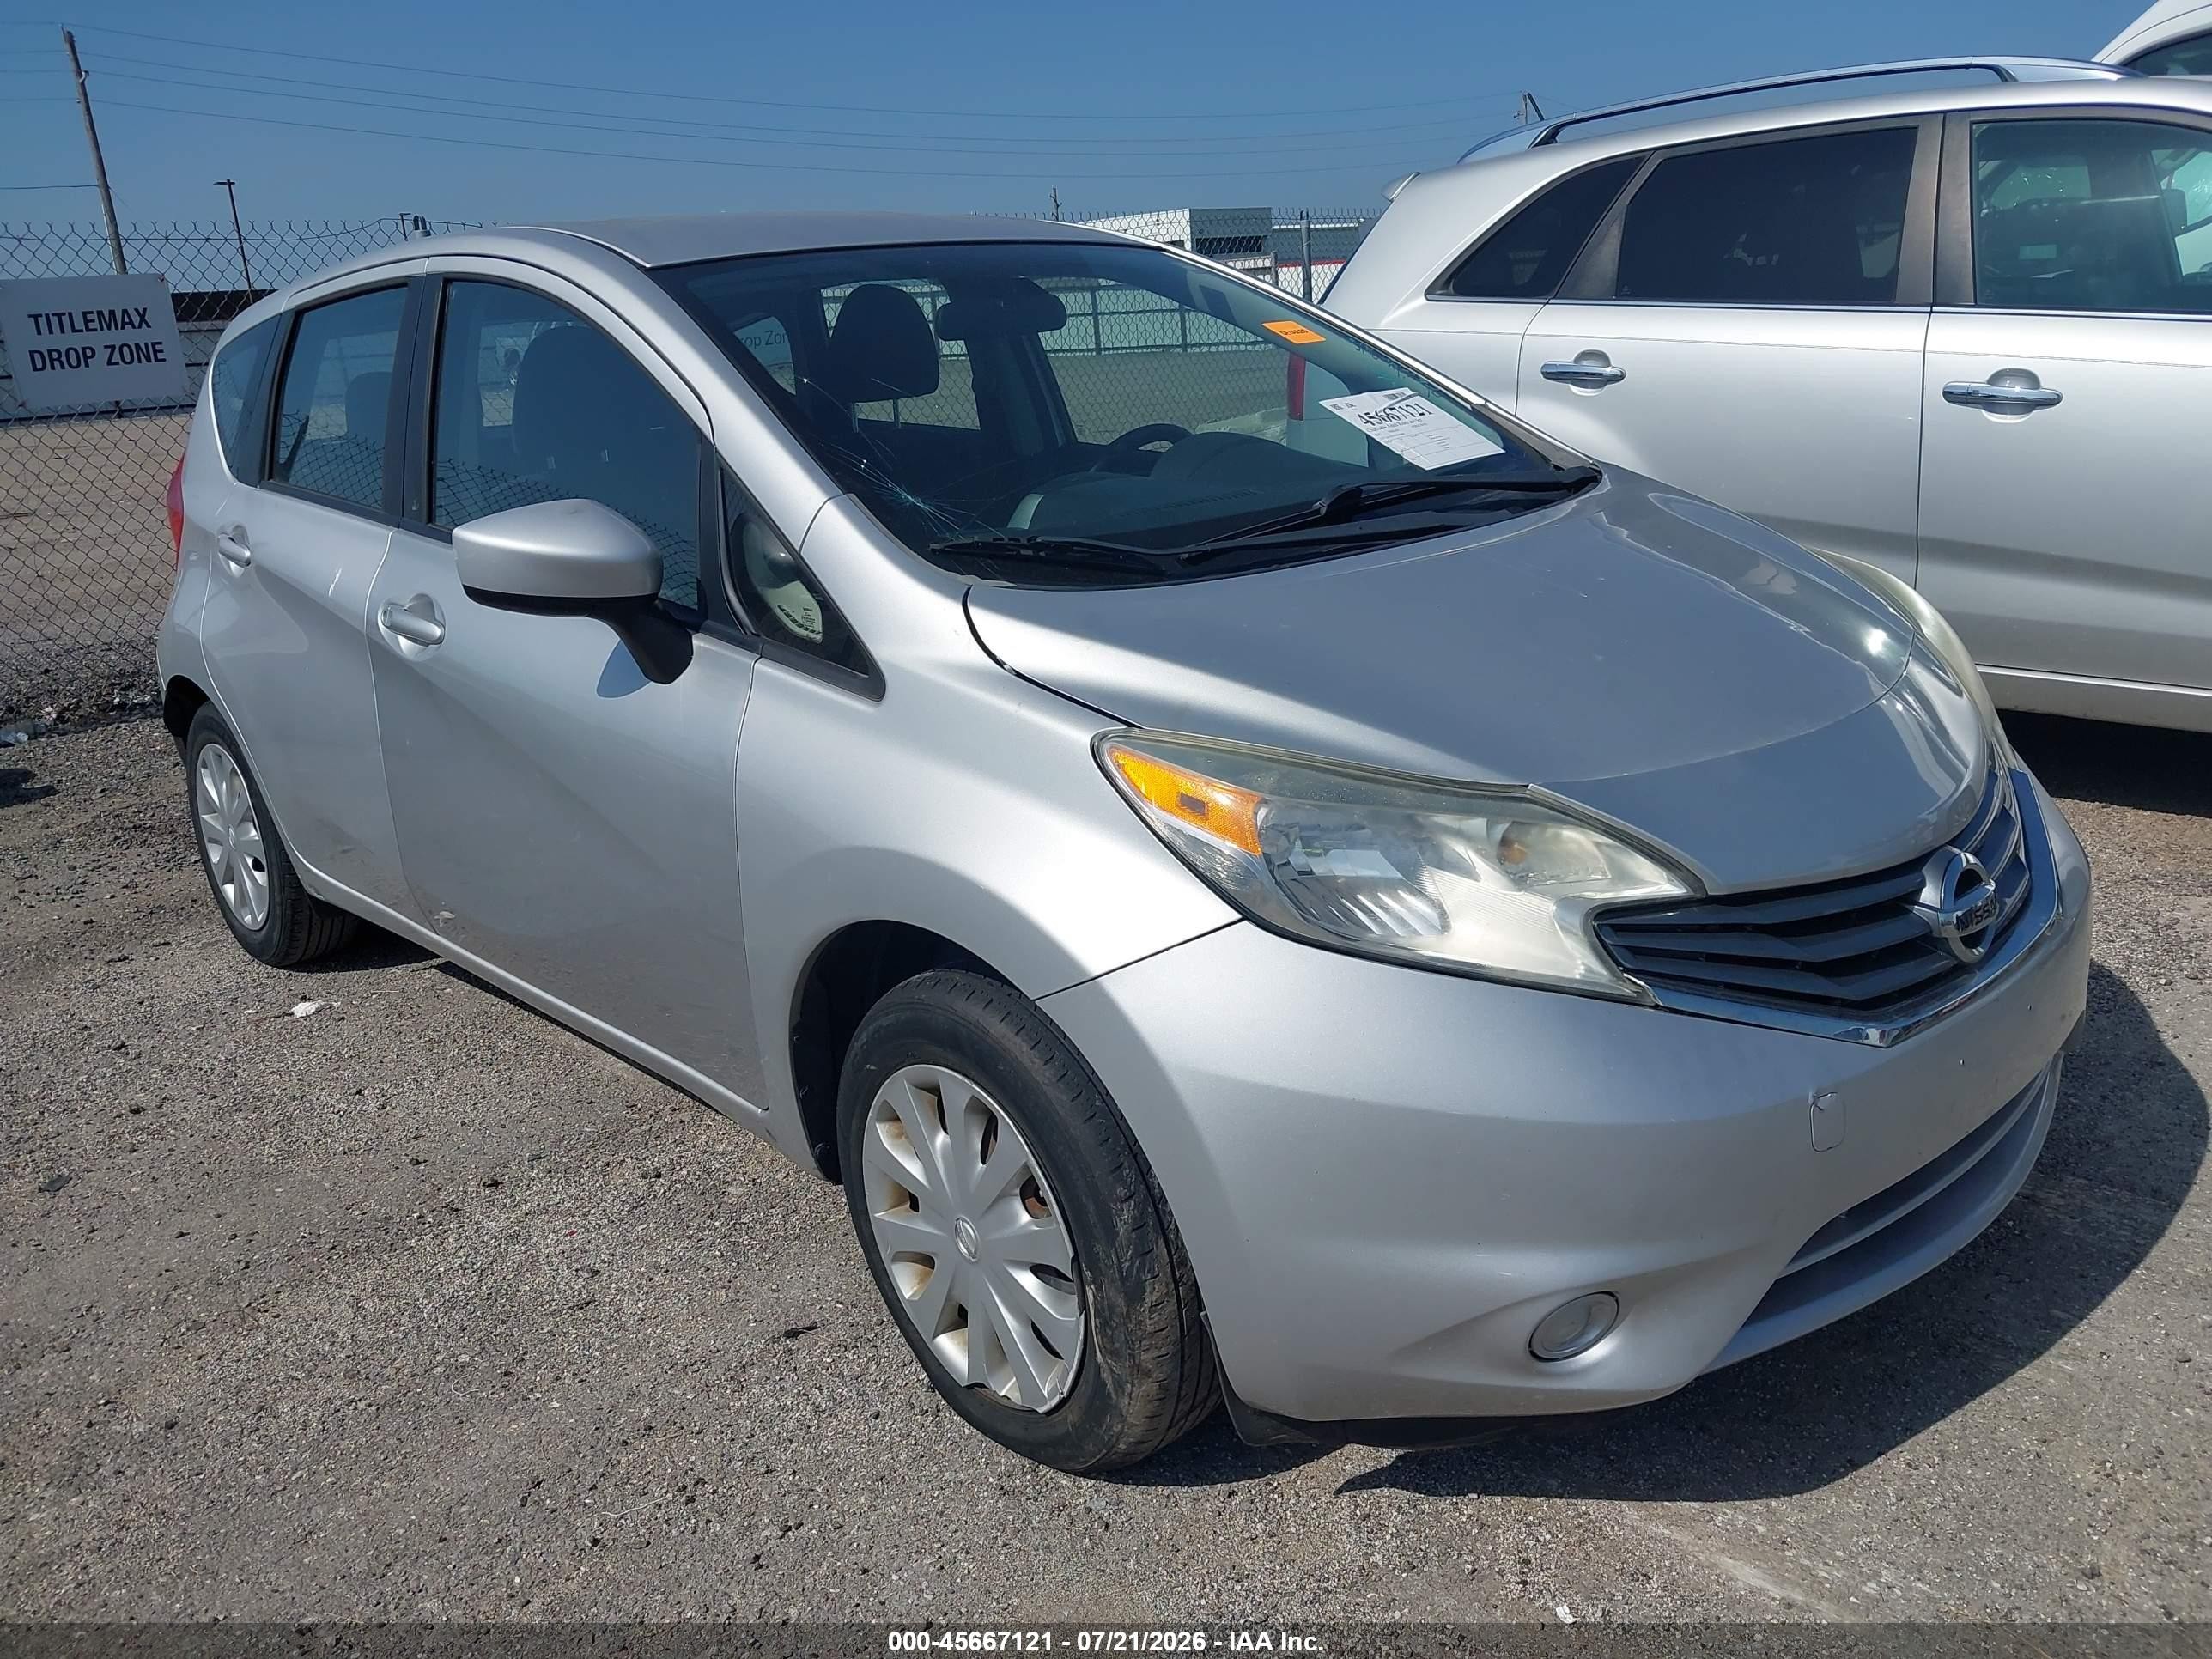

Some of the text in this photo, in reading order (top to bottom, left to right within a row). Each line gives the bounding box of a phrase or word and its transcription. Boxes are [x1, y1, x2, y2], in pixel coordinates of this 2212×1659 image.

[27, 307, 151, 336] TITLEMAX
[28, 342, 167, 372] DROP ZONE
[1358, 403, 1433, 426] 45667121
